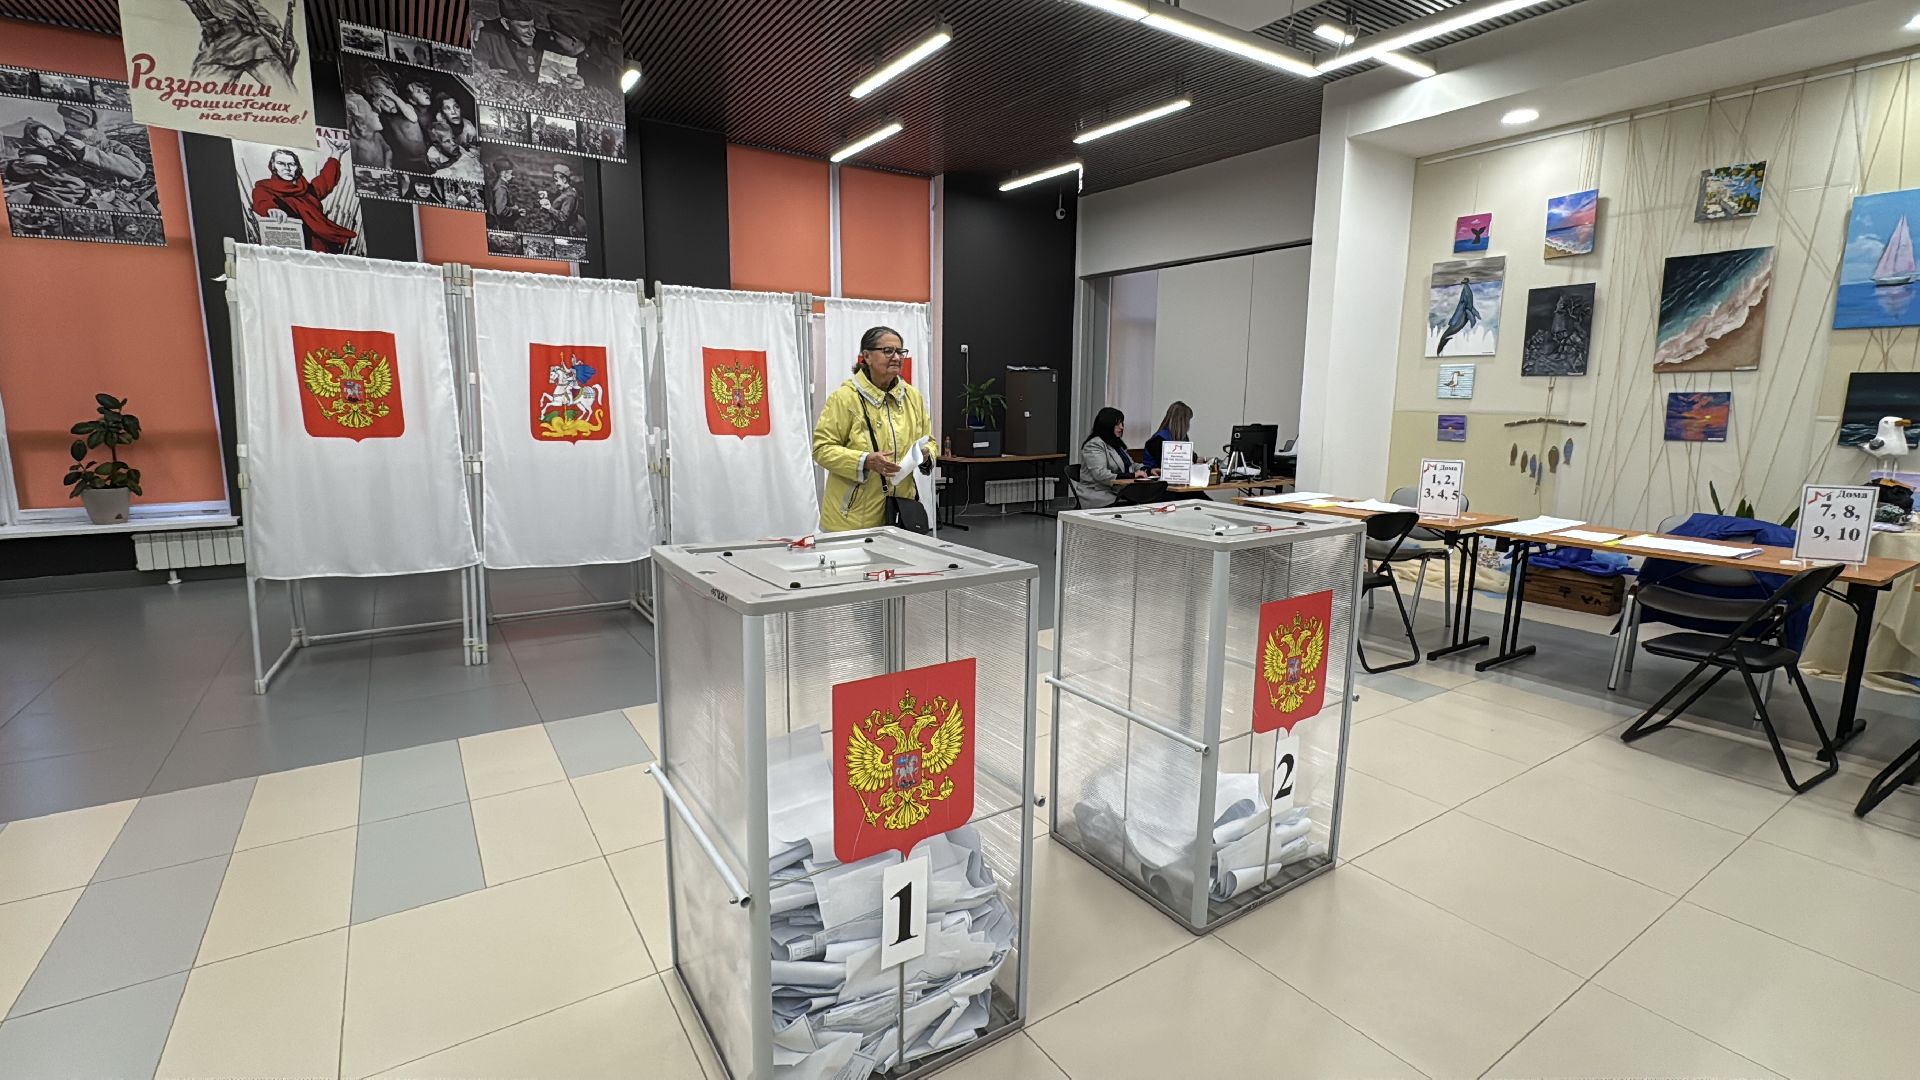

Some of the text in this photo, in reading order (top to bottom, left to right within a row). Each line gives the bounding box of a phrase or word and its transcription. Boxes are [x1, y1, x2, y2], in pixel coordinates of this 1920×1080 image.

[131, 53, 272, 101] Разгромим
[172, 98, 291, 112] фашистских
[198, 110, 308, 125] налетчиков!
[1432, 474, 1455, 486] 1, 2,
[1424, 488, 1459, 501] 3, 4, 5
[1836, 490, 1868, 499] Дома
[1820, 504, 1860, 521] 7, 8,
[1811, 525, 1861, 542] 9, 10
[1274, 753, 1295, 800] 2
[889, 881, 919, 947] 1
